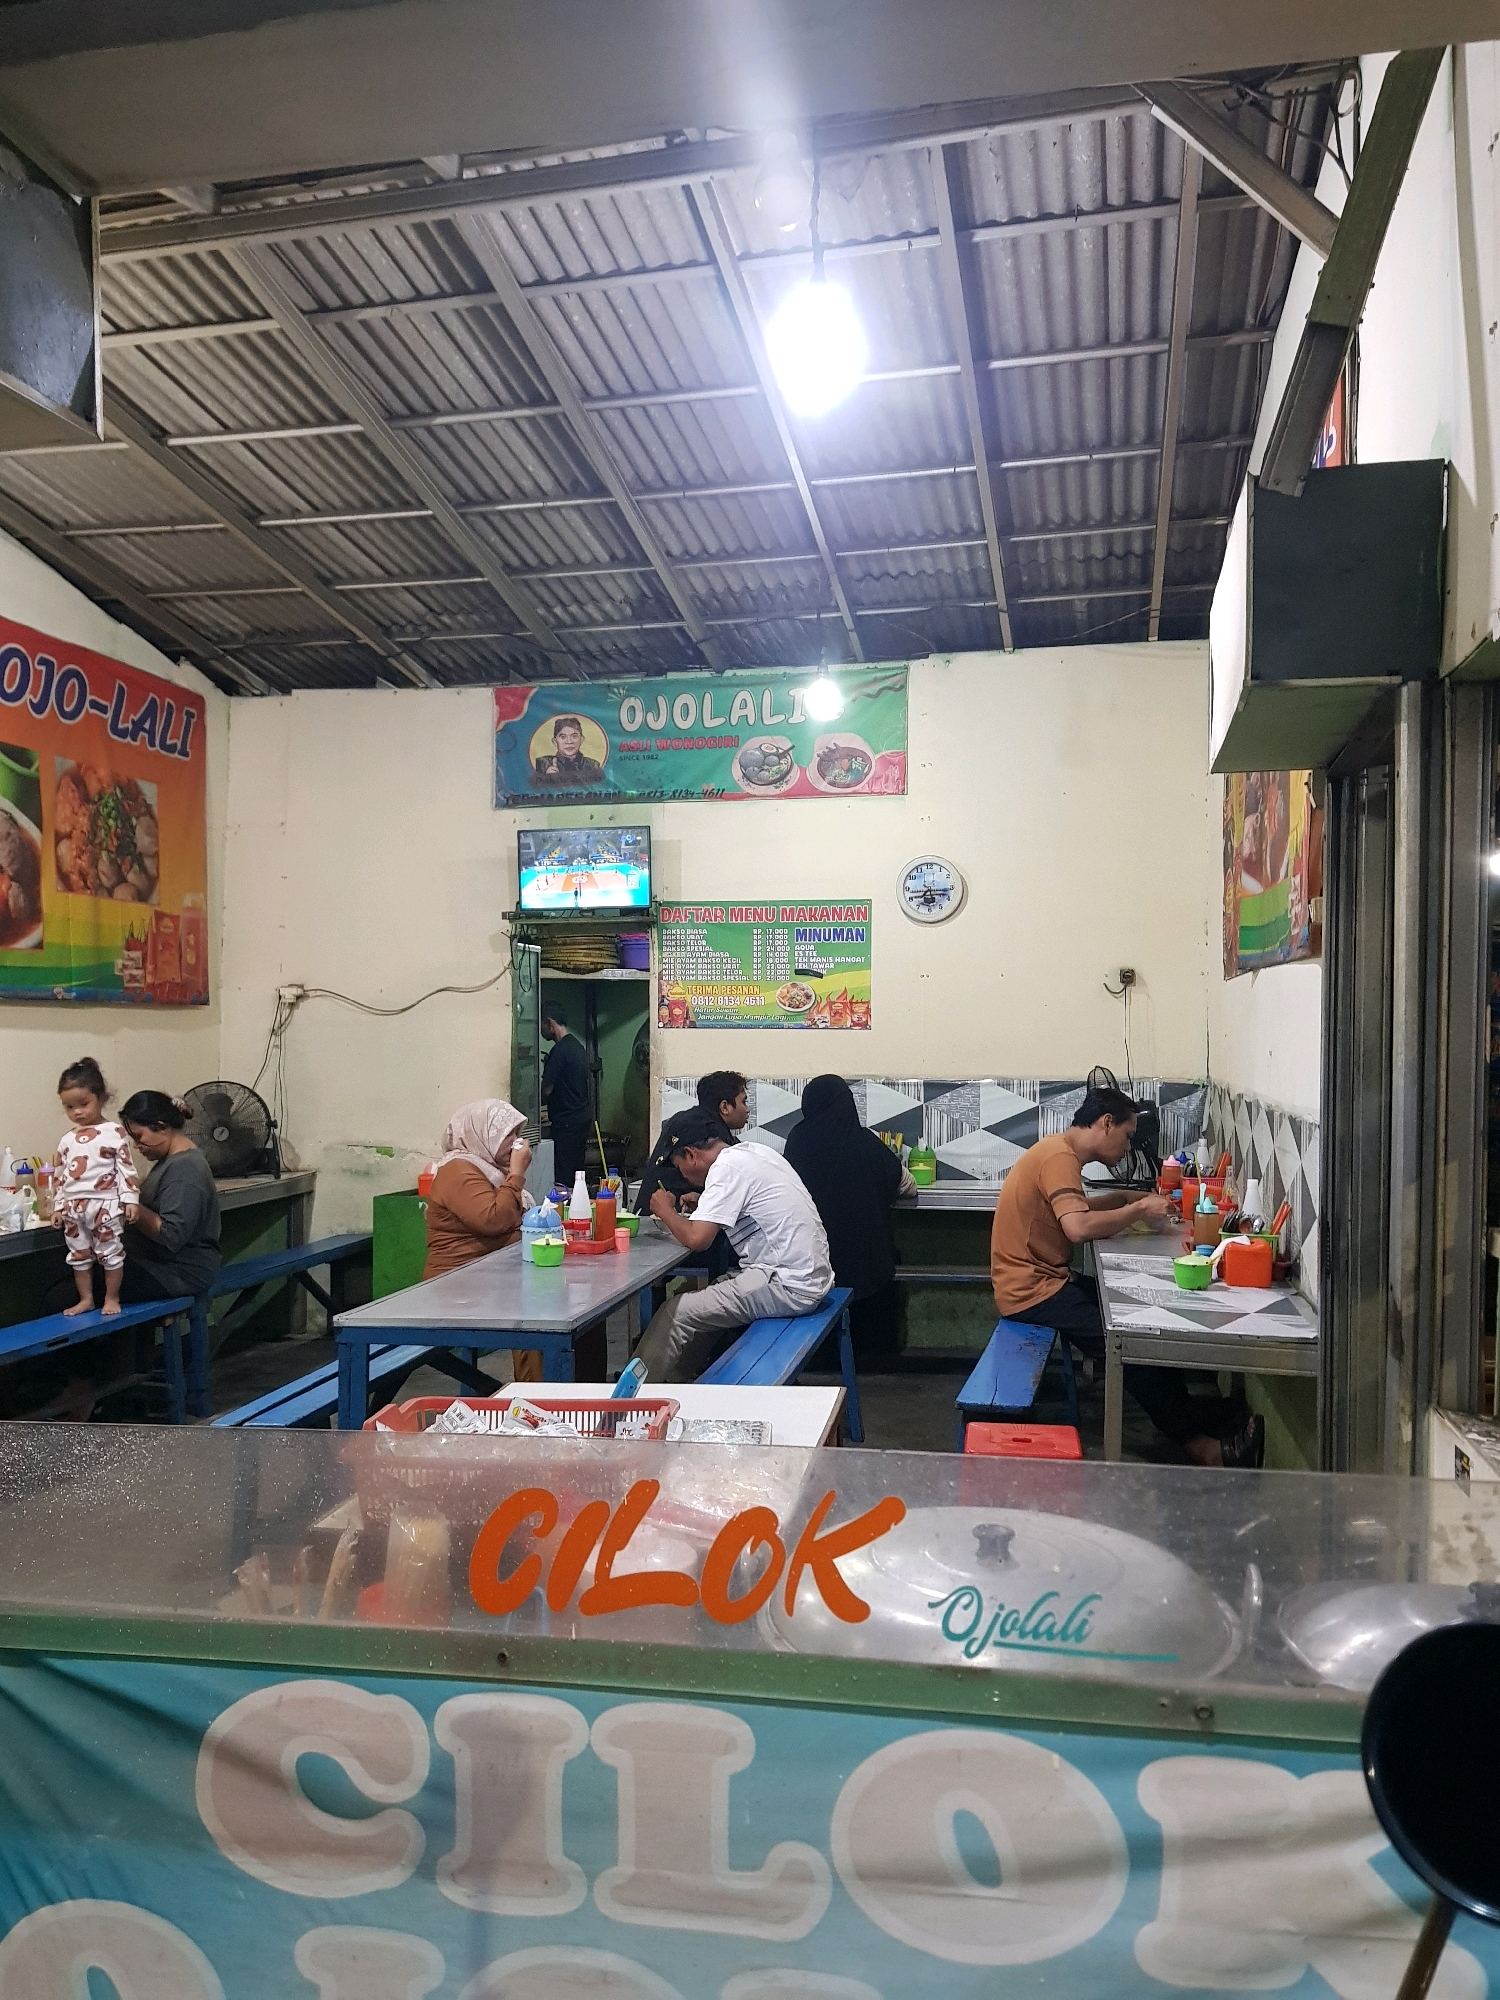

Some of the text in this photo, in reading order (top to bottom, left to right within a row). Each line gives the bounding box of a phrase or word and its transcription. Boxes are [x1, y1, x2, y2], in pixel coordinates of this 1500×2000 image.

[0, 644, 197, 760] OJO-LALI
[618, 686, 808, 733] OJOLALI
[619, 735, 739, 752] ASLI WONOGIRI
[660, 905, 869, 923] DAFTAR MENU MAKANAN
[794, 927, 866, 943] MINUMAN
[686, 985, 719, 995] TERIMA
[721, 985, 760, 995] PESANAN
[691, 996, 766, 1006] 0812 8134 4611
[469, 1478, 906, 1624] CILOK
[928, 1584, 1103, 1659] Ojolali
[195, 1679, 1487, 2000] CILOK
